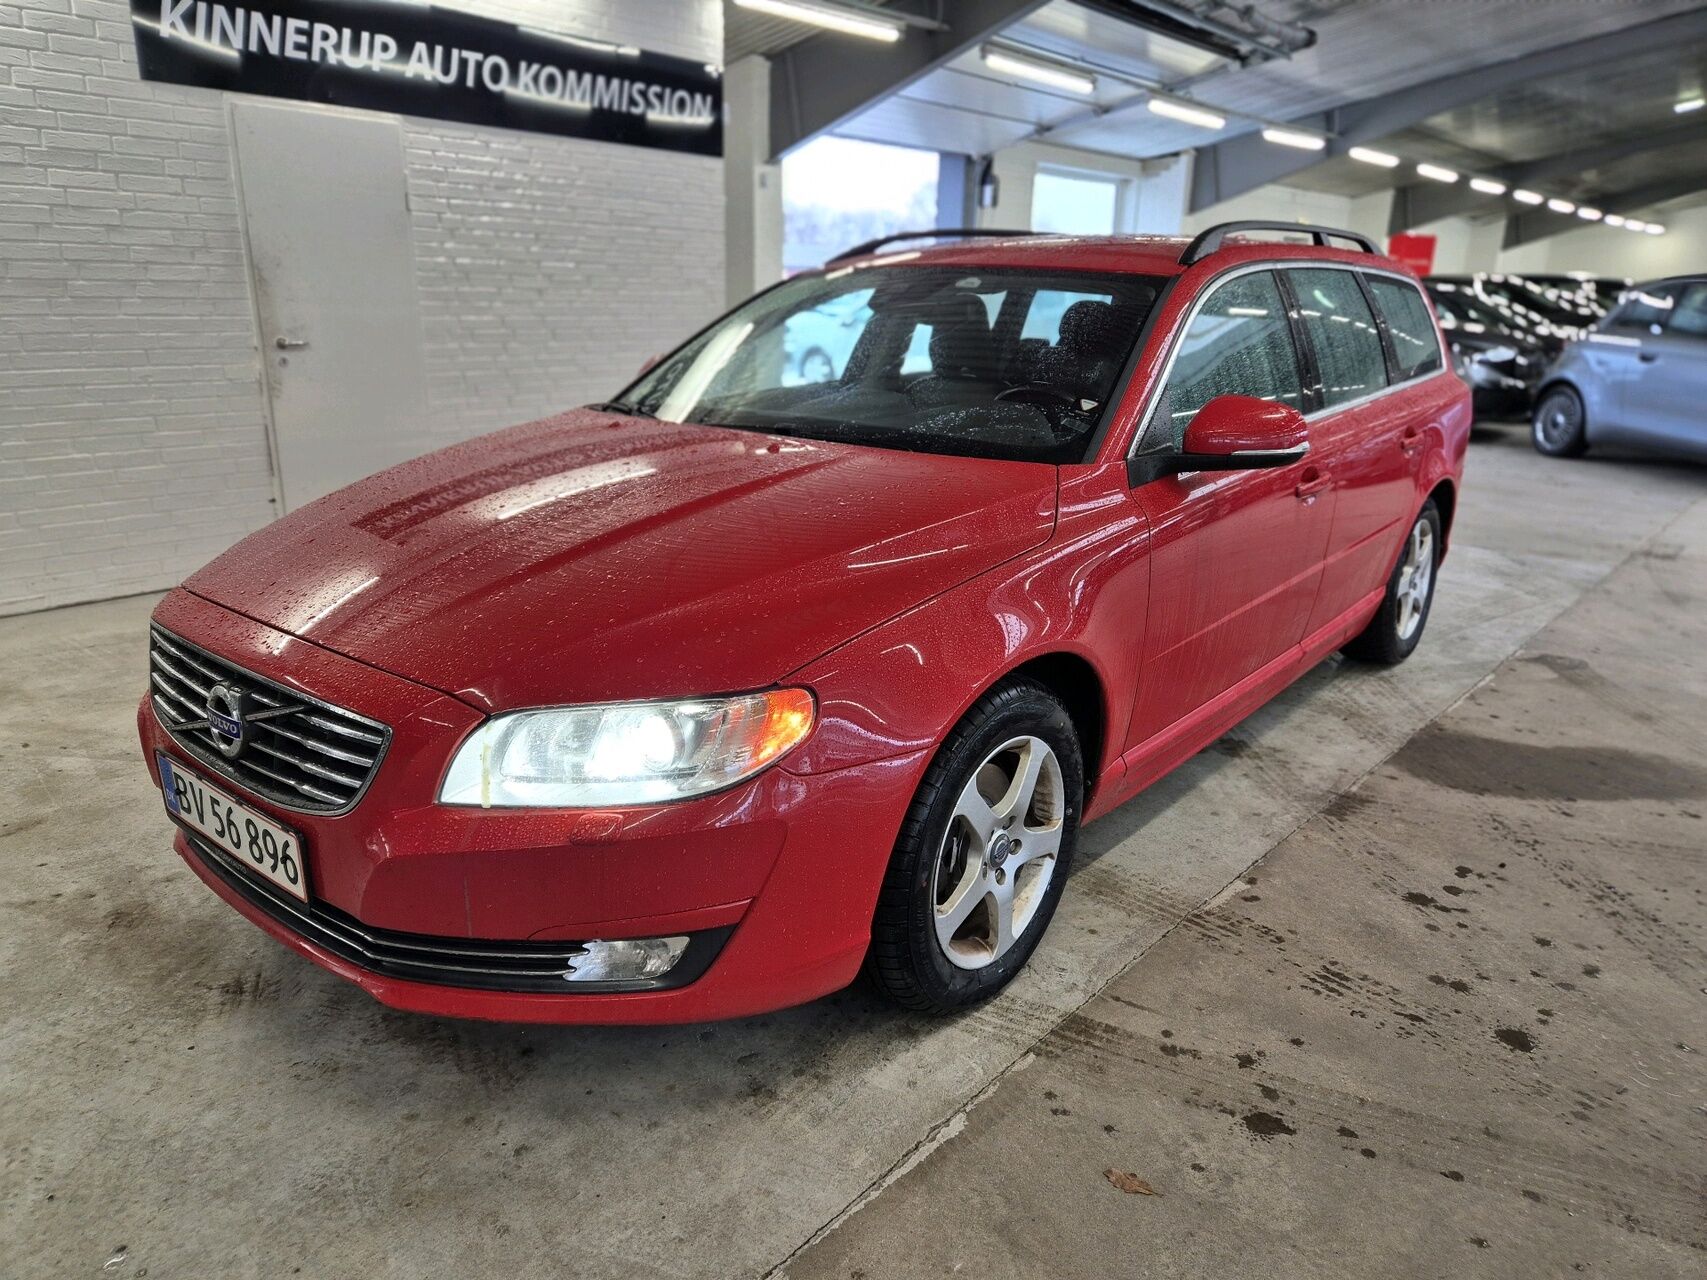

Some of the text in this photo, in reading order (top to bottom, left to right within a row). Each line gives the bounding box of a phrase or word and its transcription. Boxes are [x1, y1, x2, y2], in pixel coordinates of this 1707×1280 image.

[159, 0, 714, 119] KINNERUP AUTO KOMMISSION
[207, 709, 237, 734] VOLVO
[173, 771, 205, 826] BV
[209, 795, 242, 850] 56
[245, 818, 299, 886] 896
